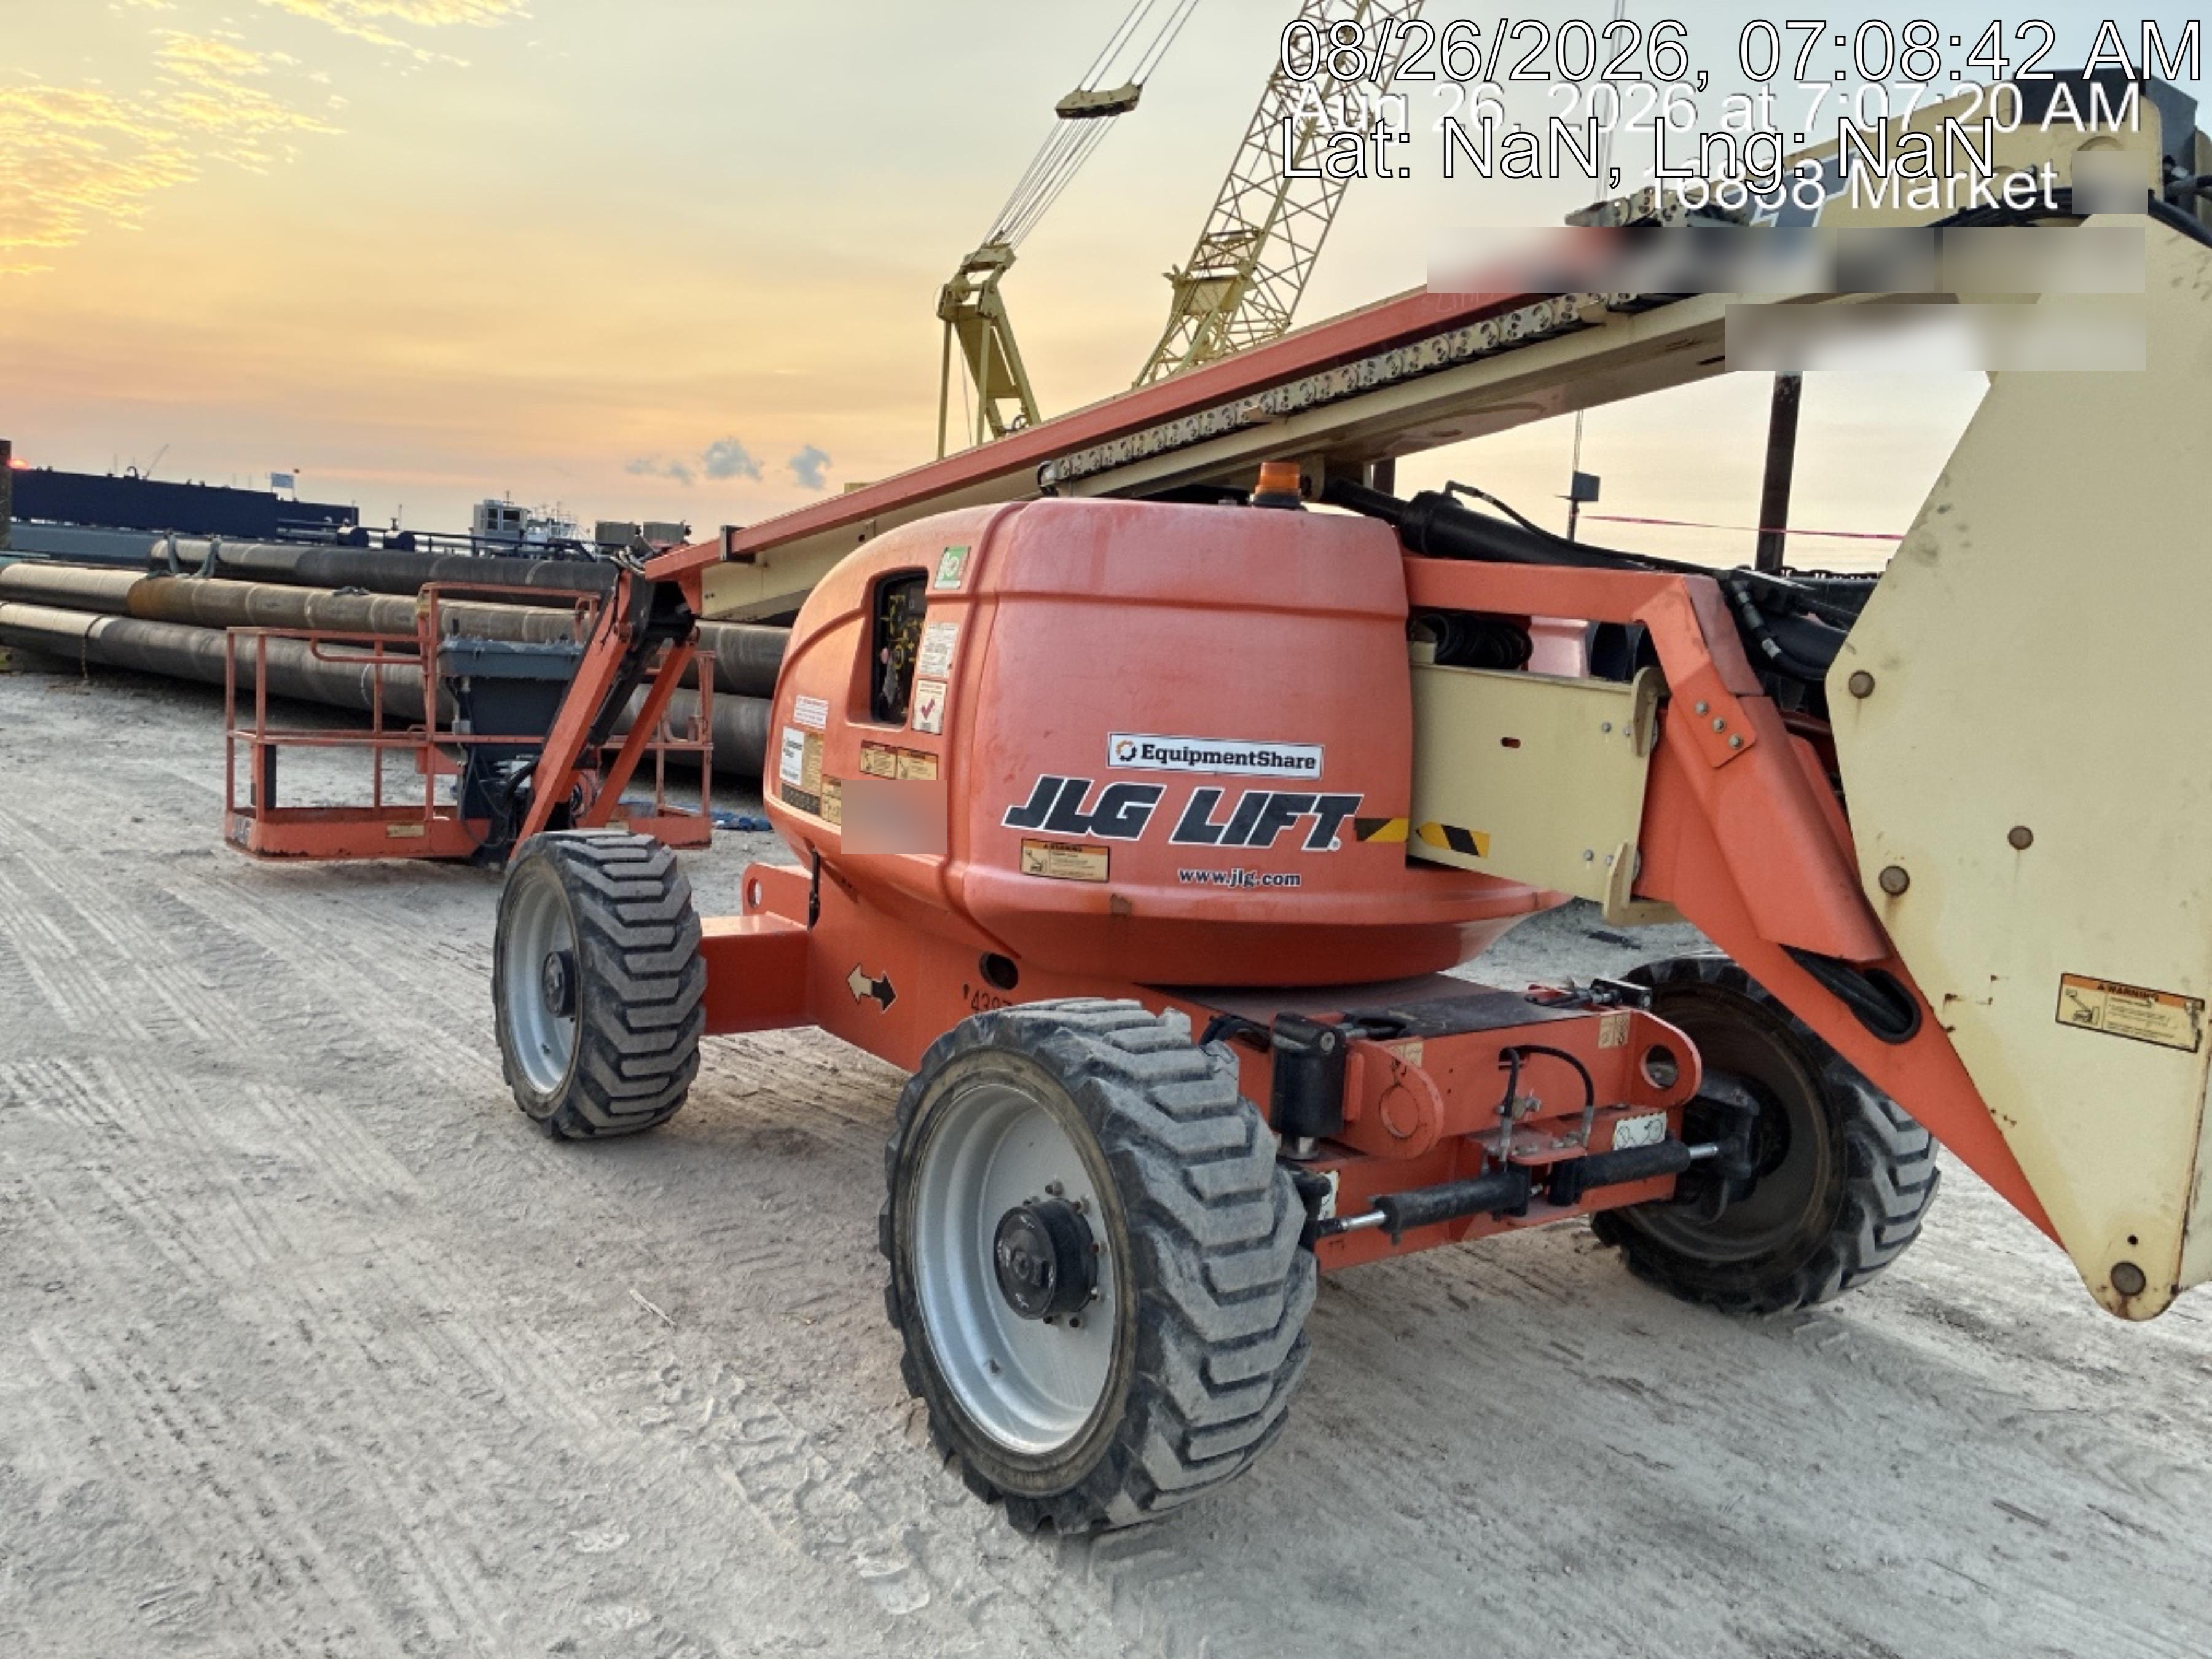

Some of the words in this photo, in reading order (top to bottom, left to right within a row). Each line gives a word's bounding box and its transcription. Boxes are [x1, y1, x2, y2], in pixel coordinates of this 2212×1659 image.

[1141, 743, 1316, 769] EquipmentShare
[1001, 774, 1168, 841] JLG
[1168, 786, 1365, 852] LIFT
[1178, 868, 1301, 888] www.jlg.com
